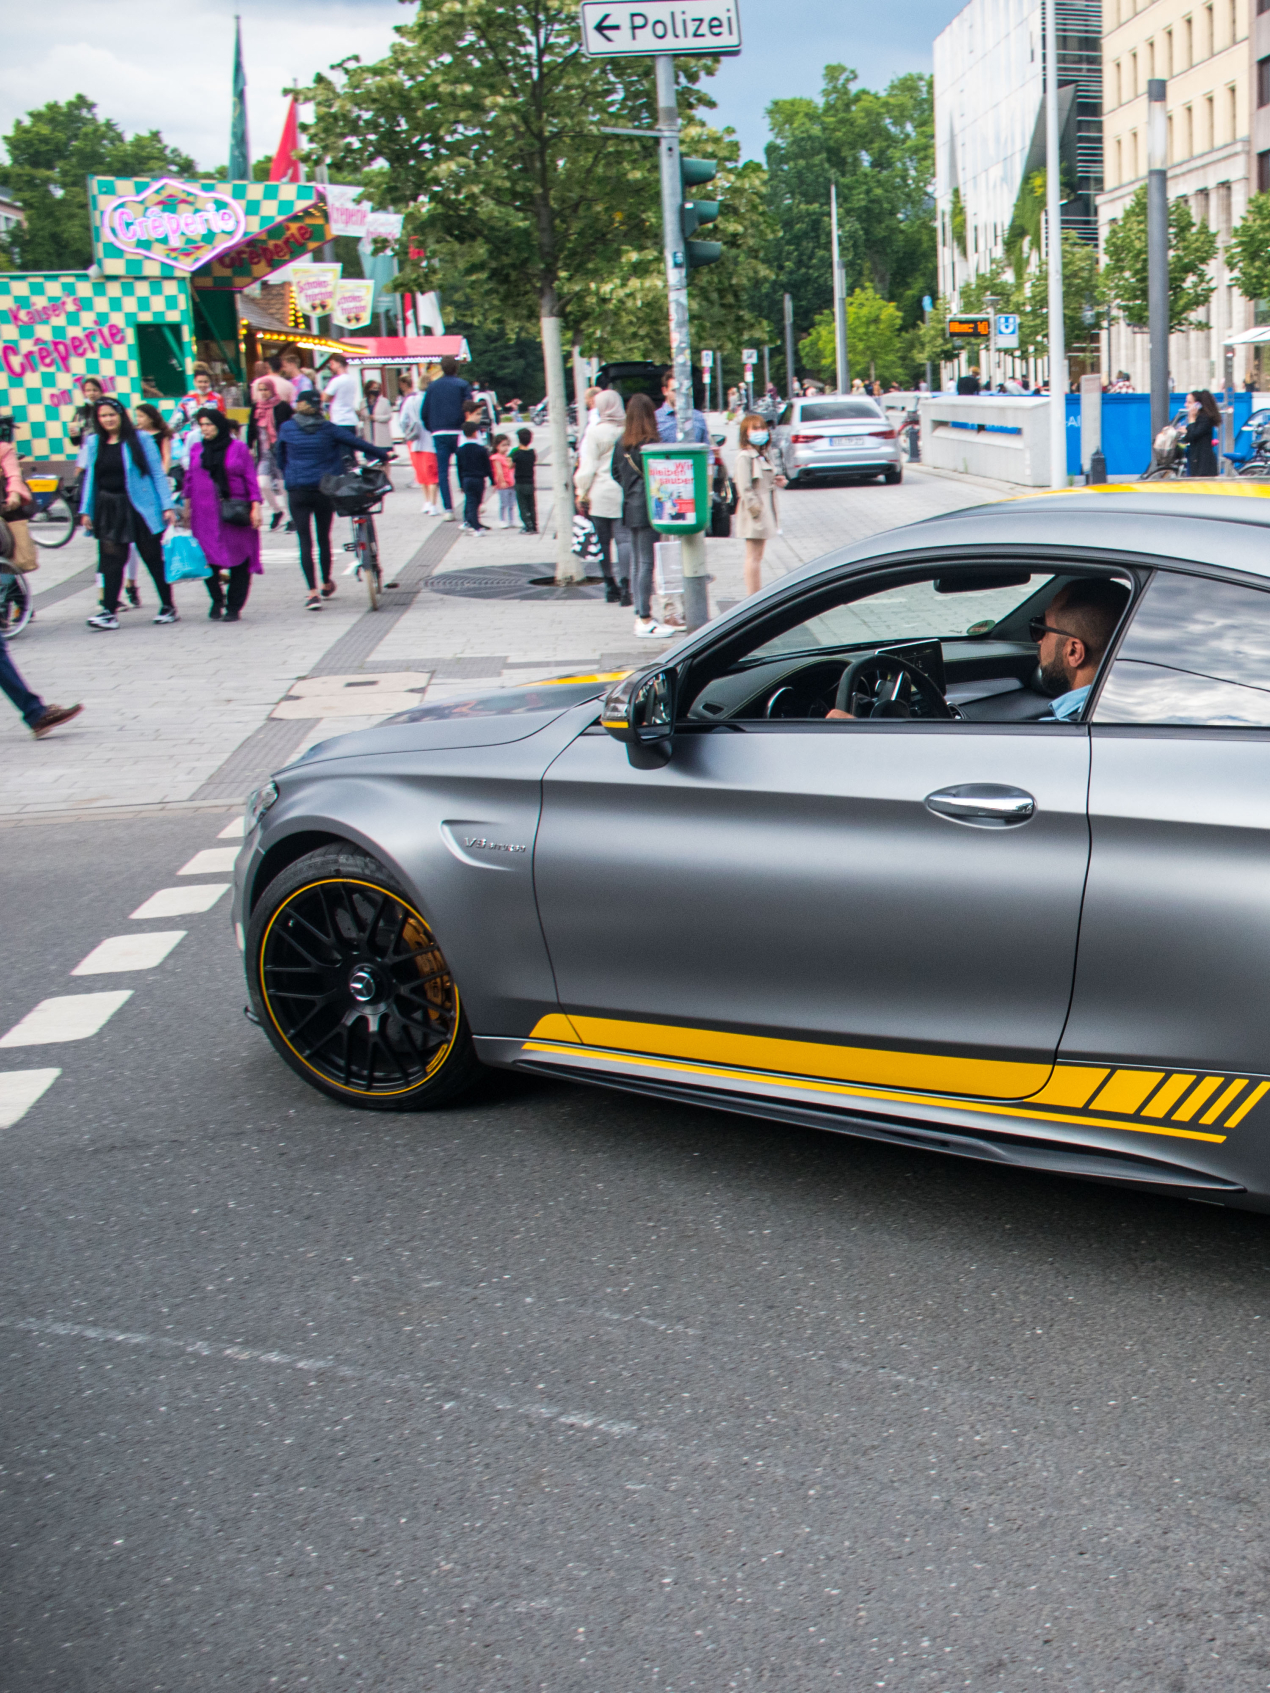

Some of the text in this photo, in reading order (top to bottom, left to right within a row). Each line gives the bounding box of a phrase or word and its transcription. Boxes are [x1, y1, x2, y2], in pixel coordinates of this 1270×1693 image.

[629, 8, 735, 40] Polizei
[113, 203, 238, 246] Crêperie
[217, 223, 314, 269] Crêperie
[8, 292, 82, 327] Kaiser's
[2, 320, 125, 378] Crêperie
[73, 375, 116, 394] Tur
[464, 838, 487, 849] V8
